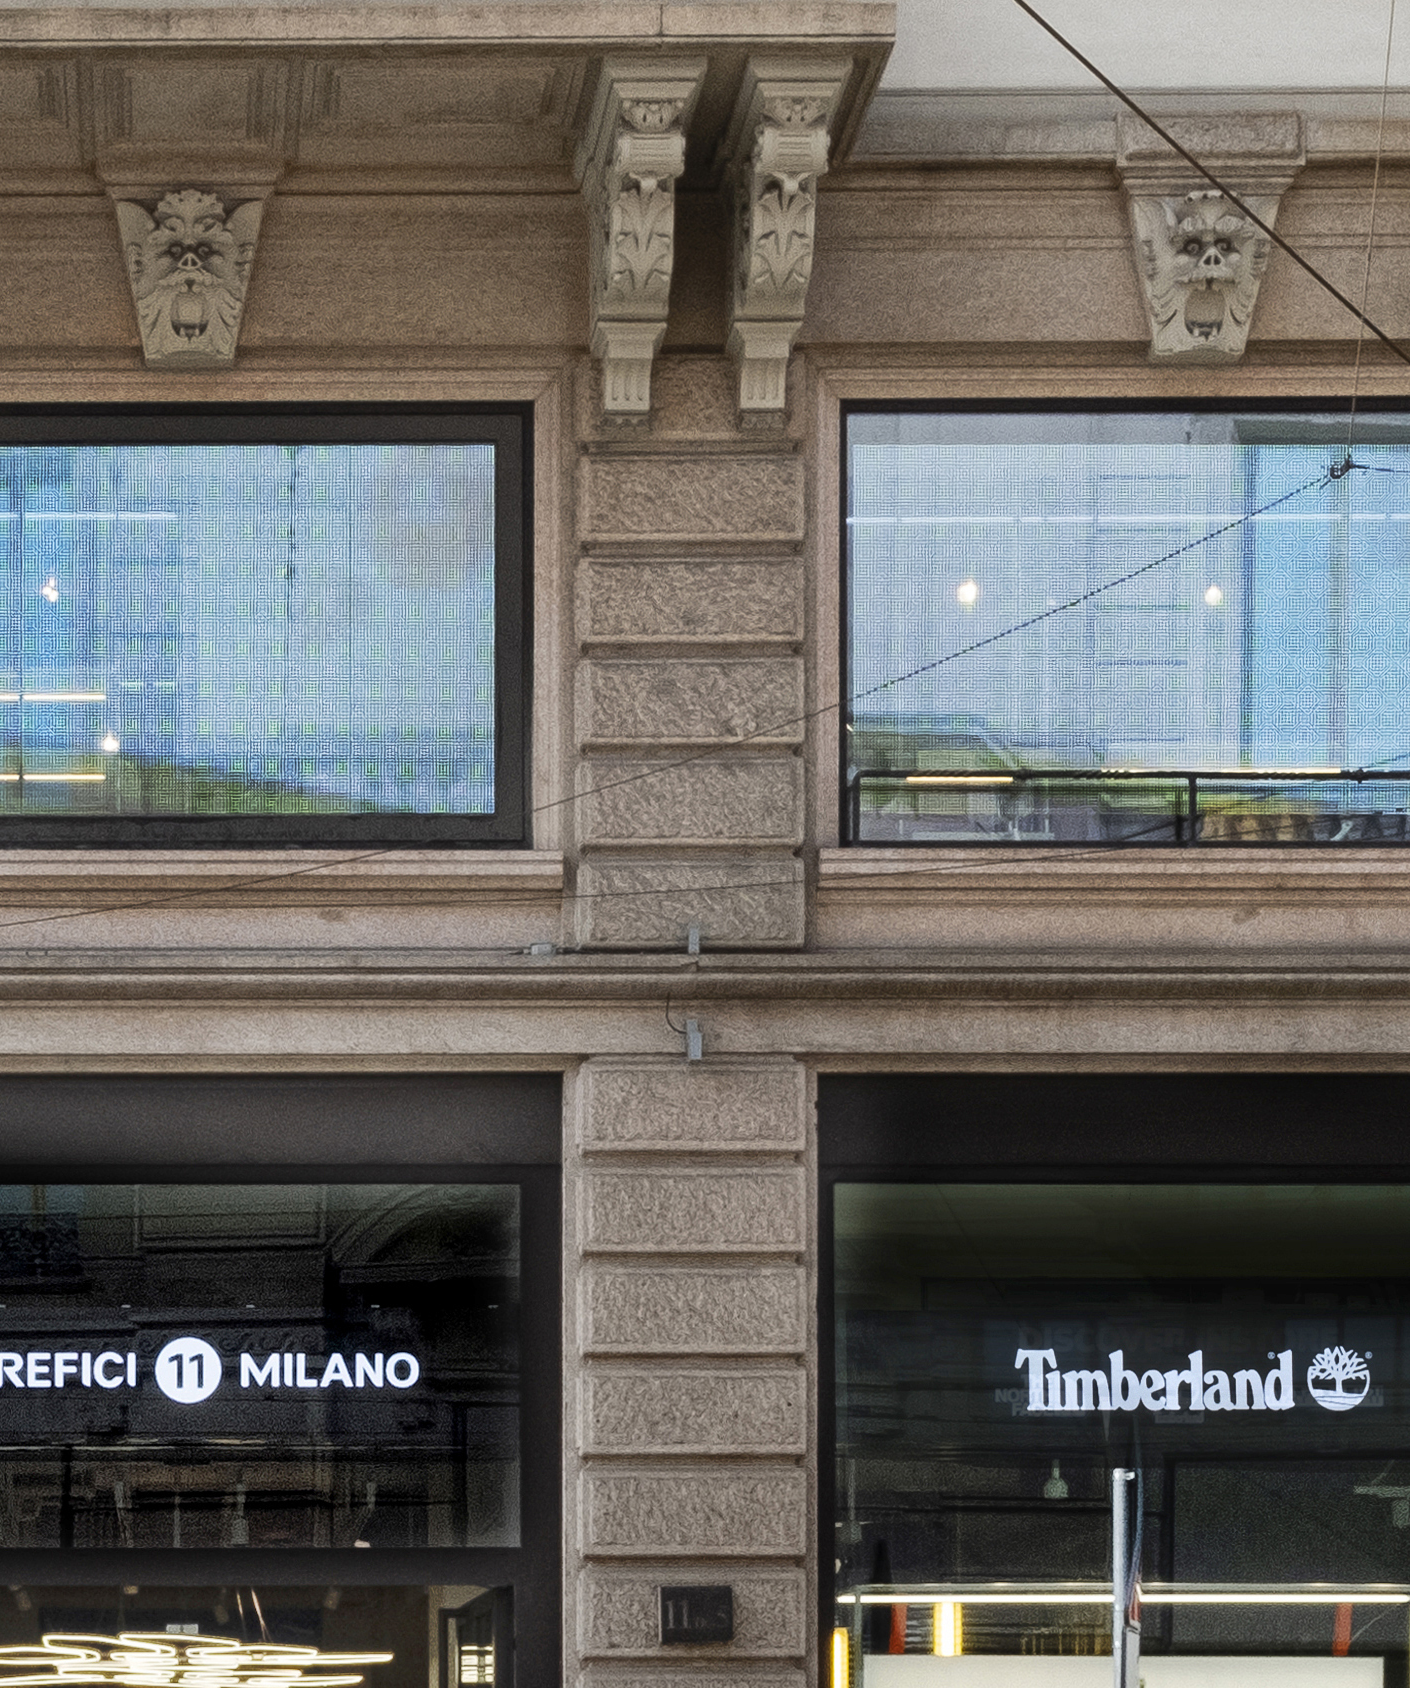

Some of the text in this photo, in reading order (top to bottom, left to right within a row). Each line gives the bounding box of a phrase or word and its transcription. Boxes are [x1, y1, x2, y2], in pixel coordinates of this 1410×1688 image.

[167, 1353, 206, 1390] 11
[240, 1351, 420, 1389] MILANO
[1014, 1347, 1296, 1412] Timberland
